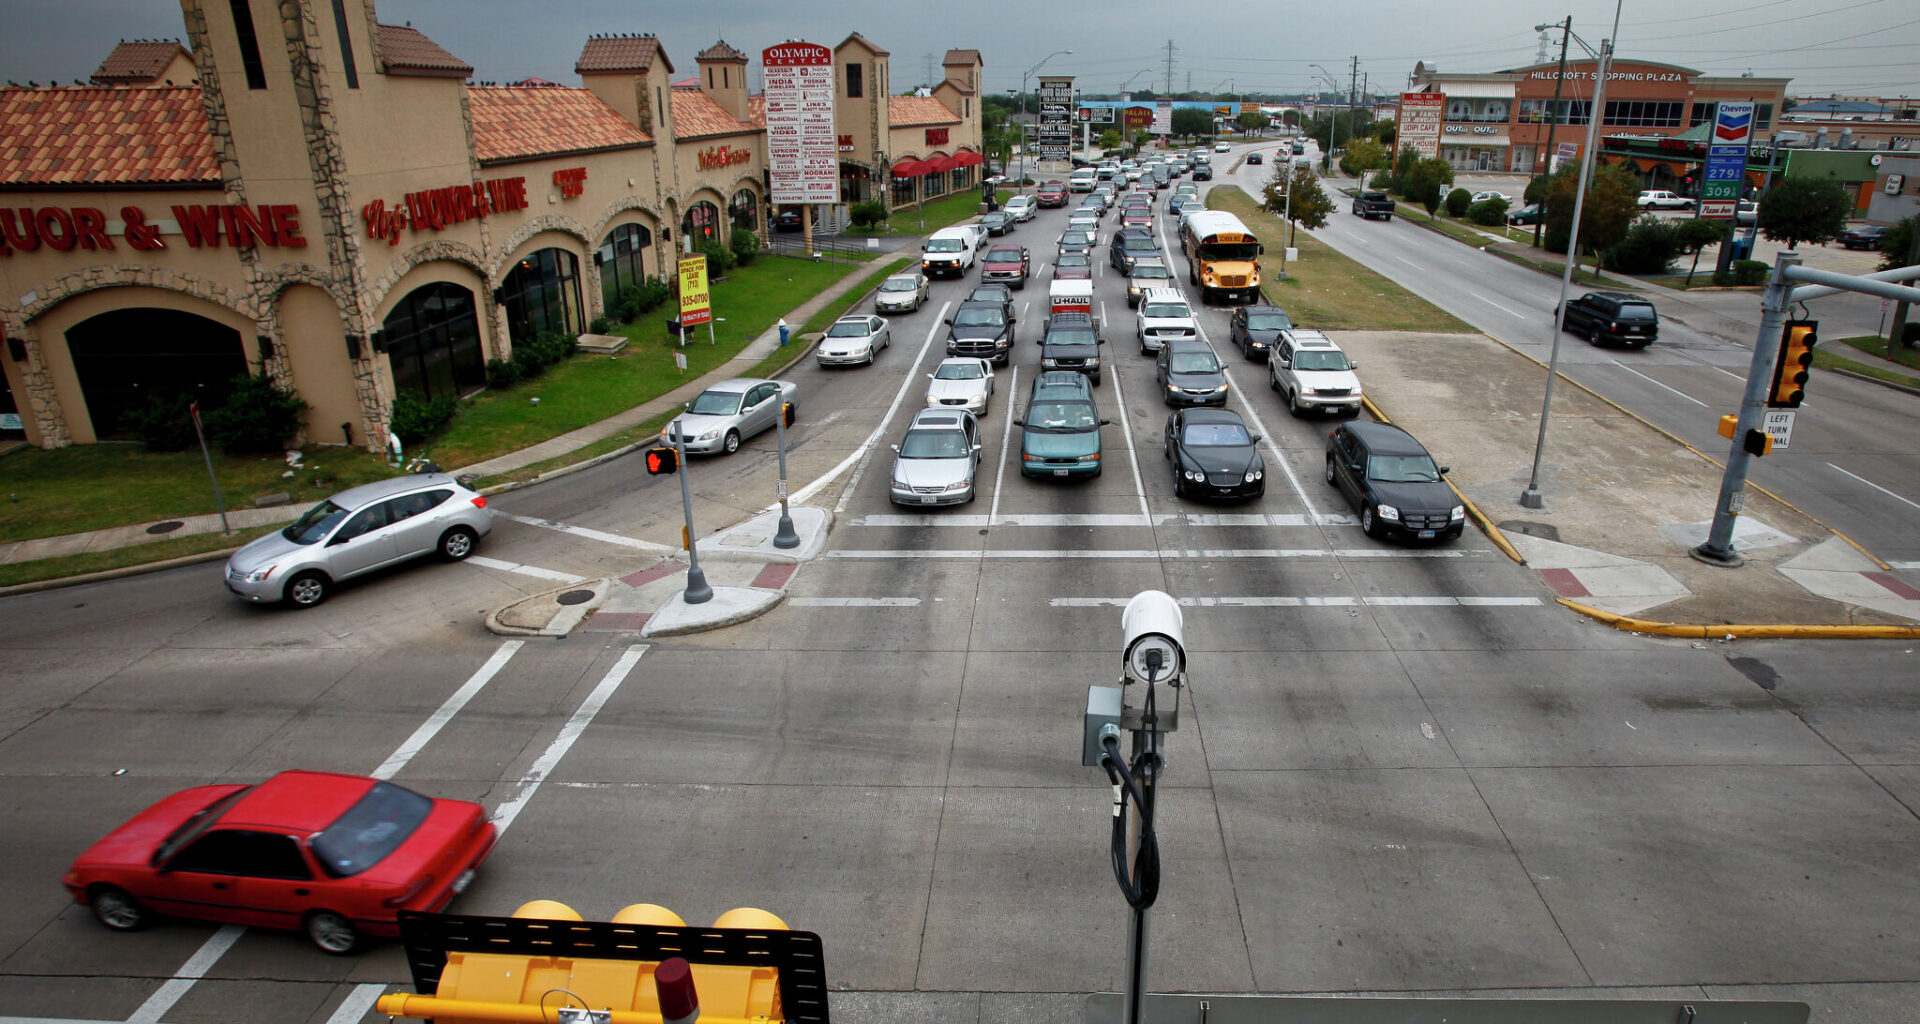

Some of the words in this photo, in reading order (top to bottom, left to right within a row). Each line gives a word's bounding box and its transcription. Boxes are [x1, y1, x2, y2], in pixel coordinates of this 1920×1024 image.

[770, 48, 824, 58] OLYMPIC
[1531, 71, 1587, 80] HILLCROFT
[1590, 71, 1643, 81] SOPPING
[1646, 72, 1682, 81] PLAZA
[1055, 88, 1071, 97] GLASS
[1720, 105, 1752, 113] Chevron
[1709, 169, 1734, 179] 279
[1706, 187, 1731, 197] 309
[405, 185, 479, 231] LIQUOR
[473, 181, 491, 217] &
[487, 176, 528, 214] WINE
[121, 206, 167, 251] &
[171, 204, 307, 249] WINE
[687, 272, 699, 280] LEASE
[682, 293, 709, 306] 935-0700
[1770, 415, 1788, 423] LEFT
[1768, 426, 1788, 434] TURN
[1773, 437, 1788, 445] NAL
